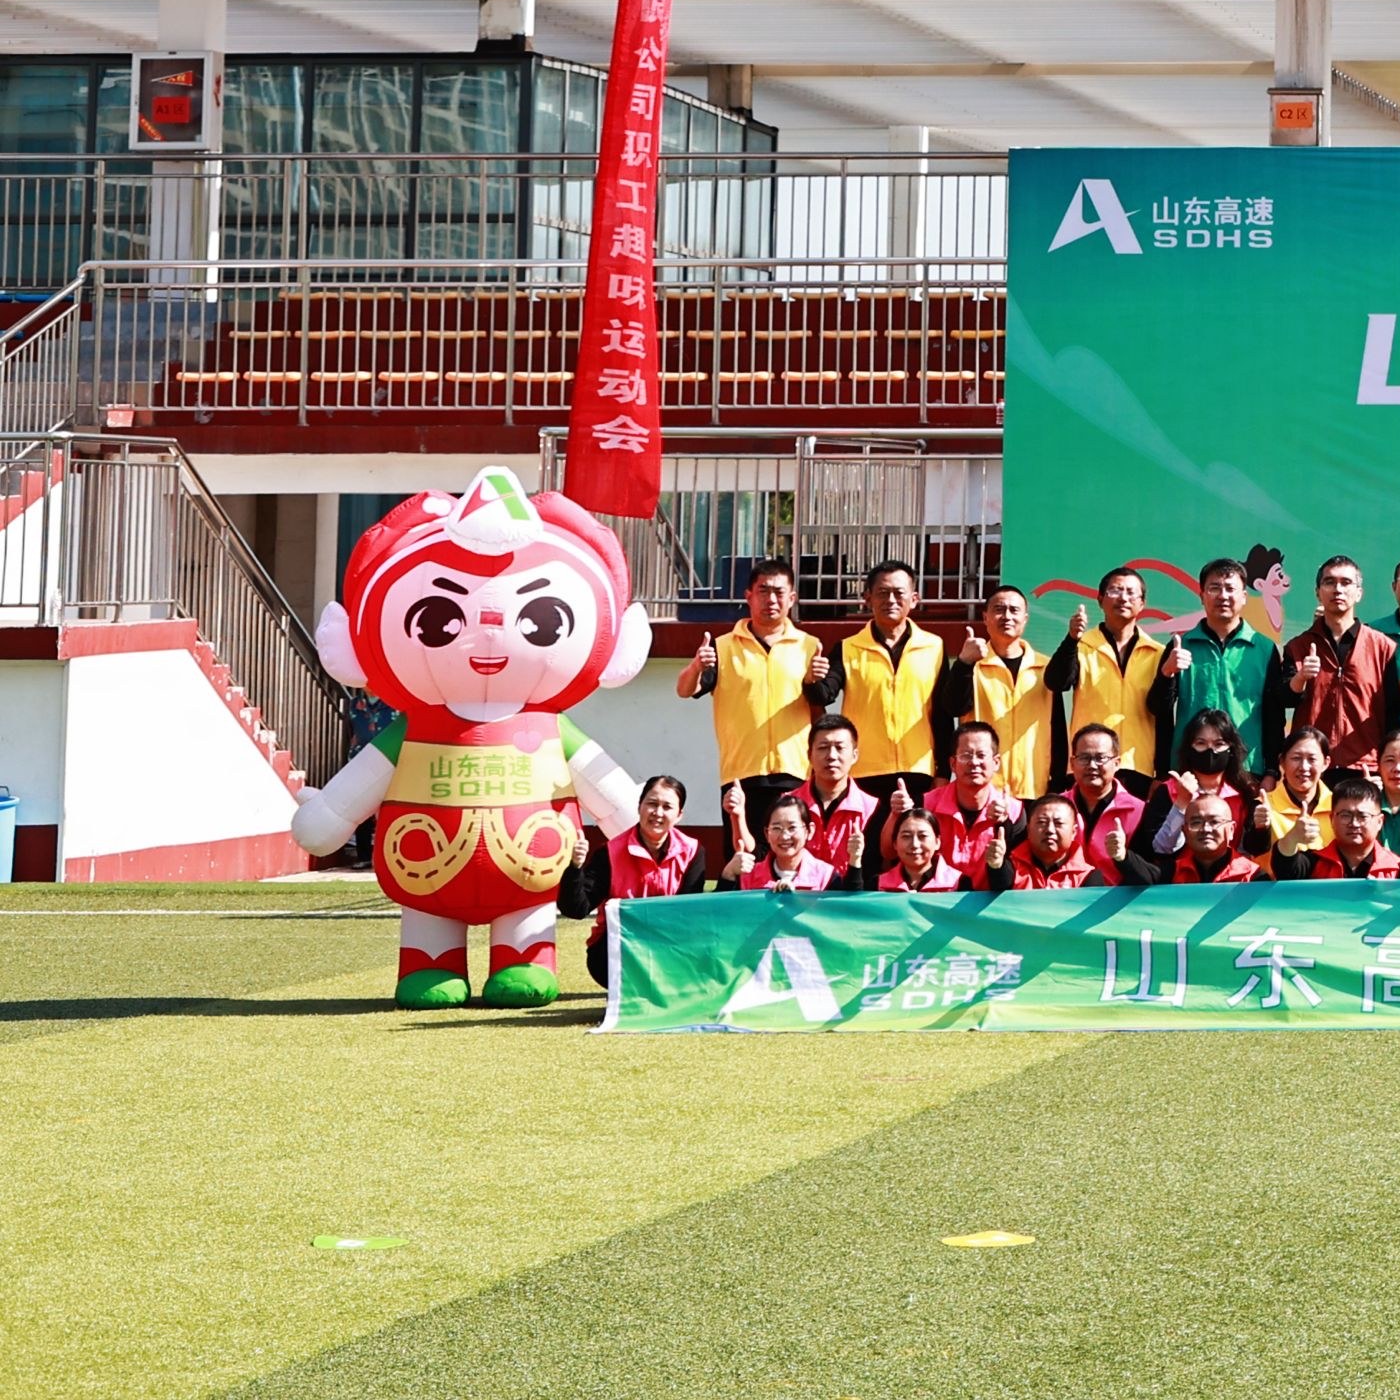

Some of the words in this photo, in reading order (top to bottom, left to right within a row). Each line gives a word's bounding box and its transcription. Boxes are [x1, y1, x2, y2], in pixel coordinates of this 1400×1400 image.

[156, 104, 170, 115] A1
[1280, 108, 1293, 120] C2
[1152, 196, 1274, 226] 山东高速
[1153, 229, 1274, 249] SDHS
[429, 753, 532, 779] 山东高速
[430, 780, 532, 798] SDHS
[860, 951, 1025, 991] 山东高速
[859, 988, 1016, 1012] SDHS
